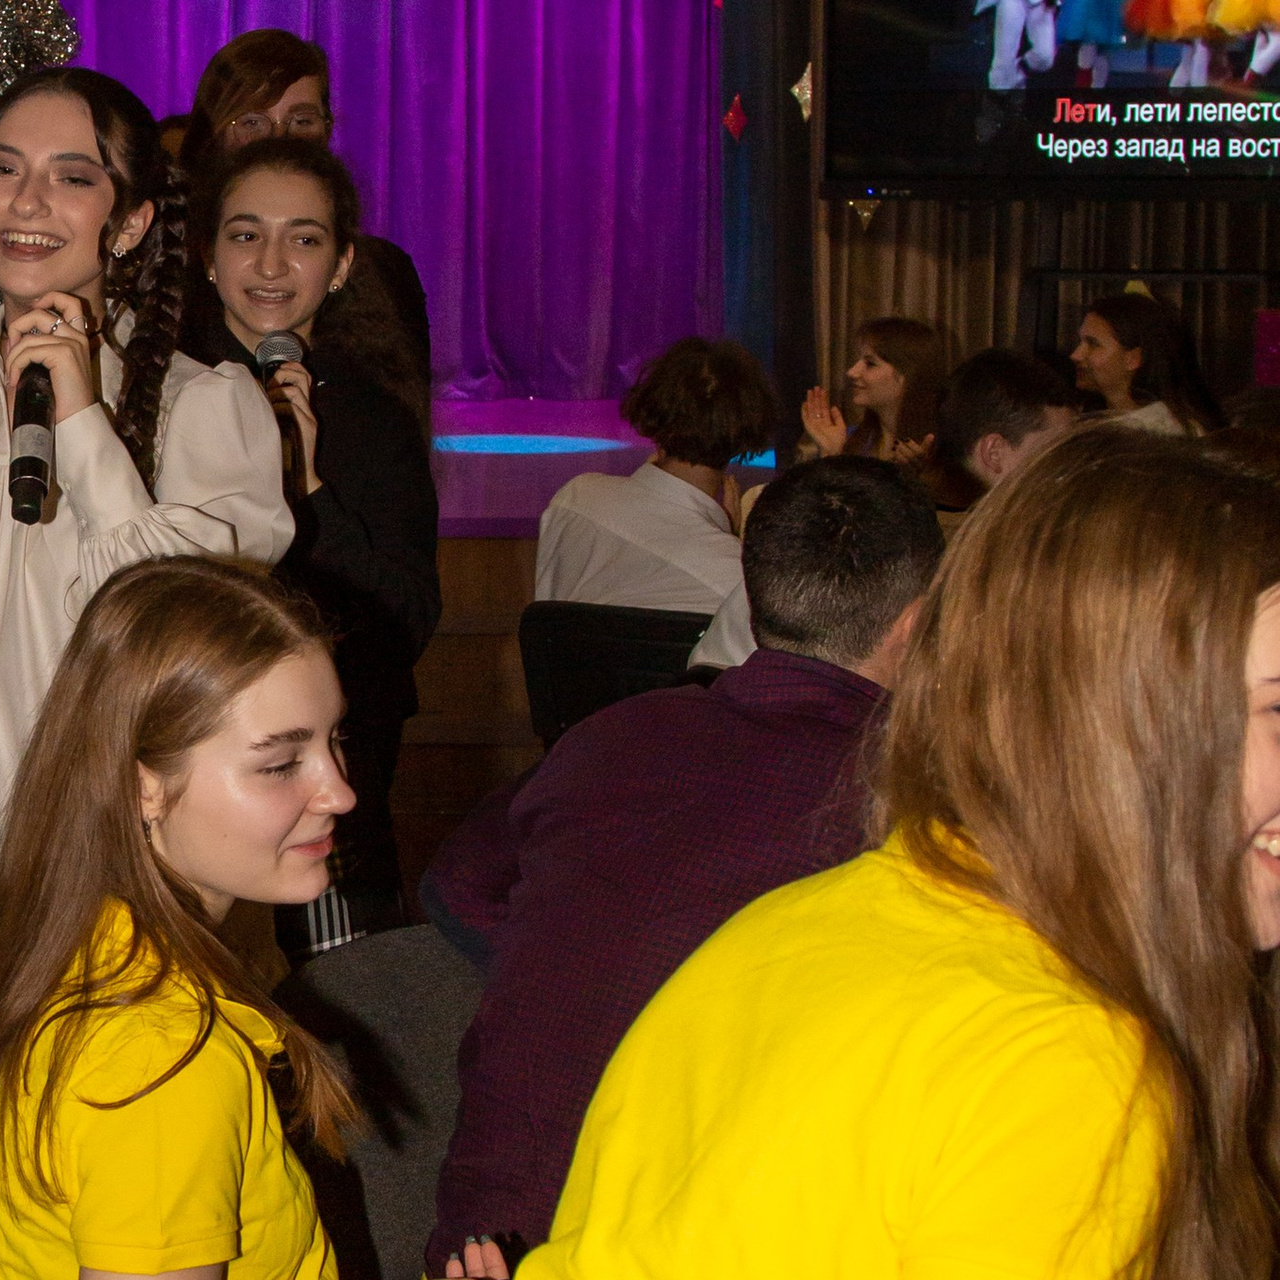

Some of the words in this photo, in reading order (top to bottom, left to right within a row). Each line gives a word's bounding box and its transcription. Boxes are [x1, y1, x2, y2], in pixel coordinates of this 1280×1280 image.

[1053, 97, 1118, 127] Лети,
[1123, 102, 1181, 122] лети
[1037, 132, 1109, 163] Через
[1114, 138, 1186, 164] запад
[1192, 137, 1221, 158] на
[1228, 137, 1280, 158] вост
